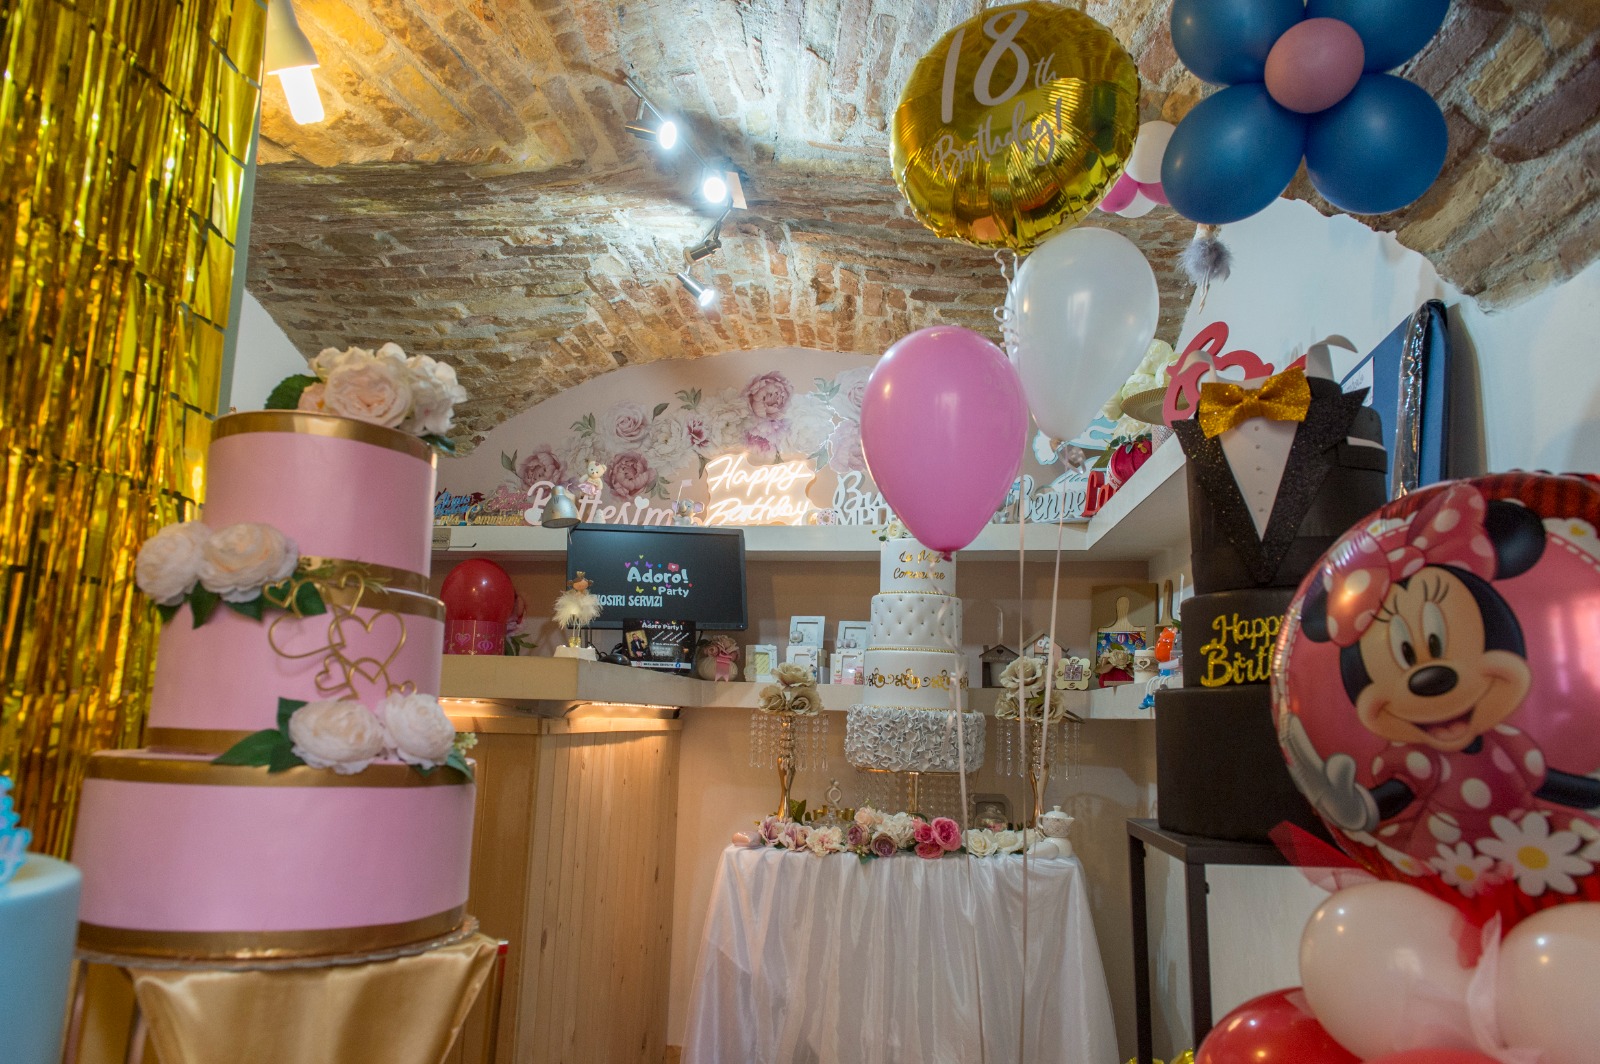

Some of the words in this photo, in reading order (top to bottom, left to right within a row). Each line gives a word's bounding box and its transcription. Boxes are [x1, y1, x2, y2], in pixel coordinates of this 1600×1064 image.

[932, 98, 1063, 180] Birthday!
[707, 455, 813, 497] Happy
[627, 566, 689, 584] Adoro!
[628, 595, 663, 607] SERVIZI
[658, 586, 690, 598] Party
[641, 621, 662, 630] Adoro
[1212, 612, 1285, 650] Happ
